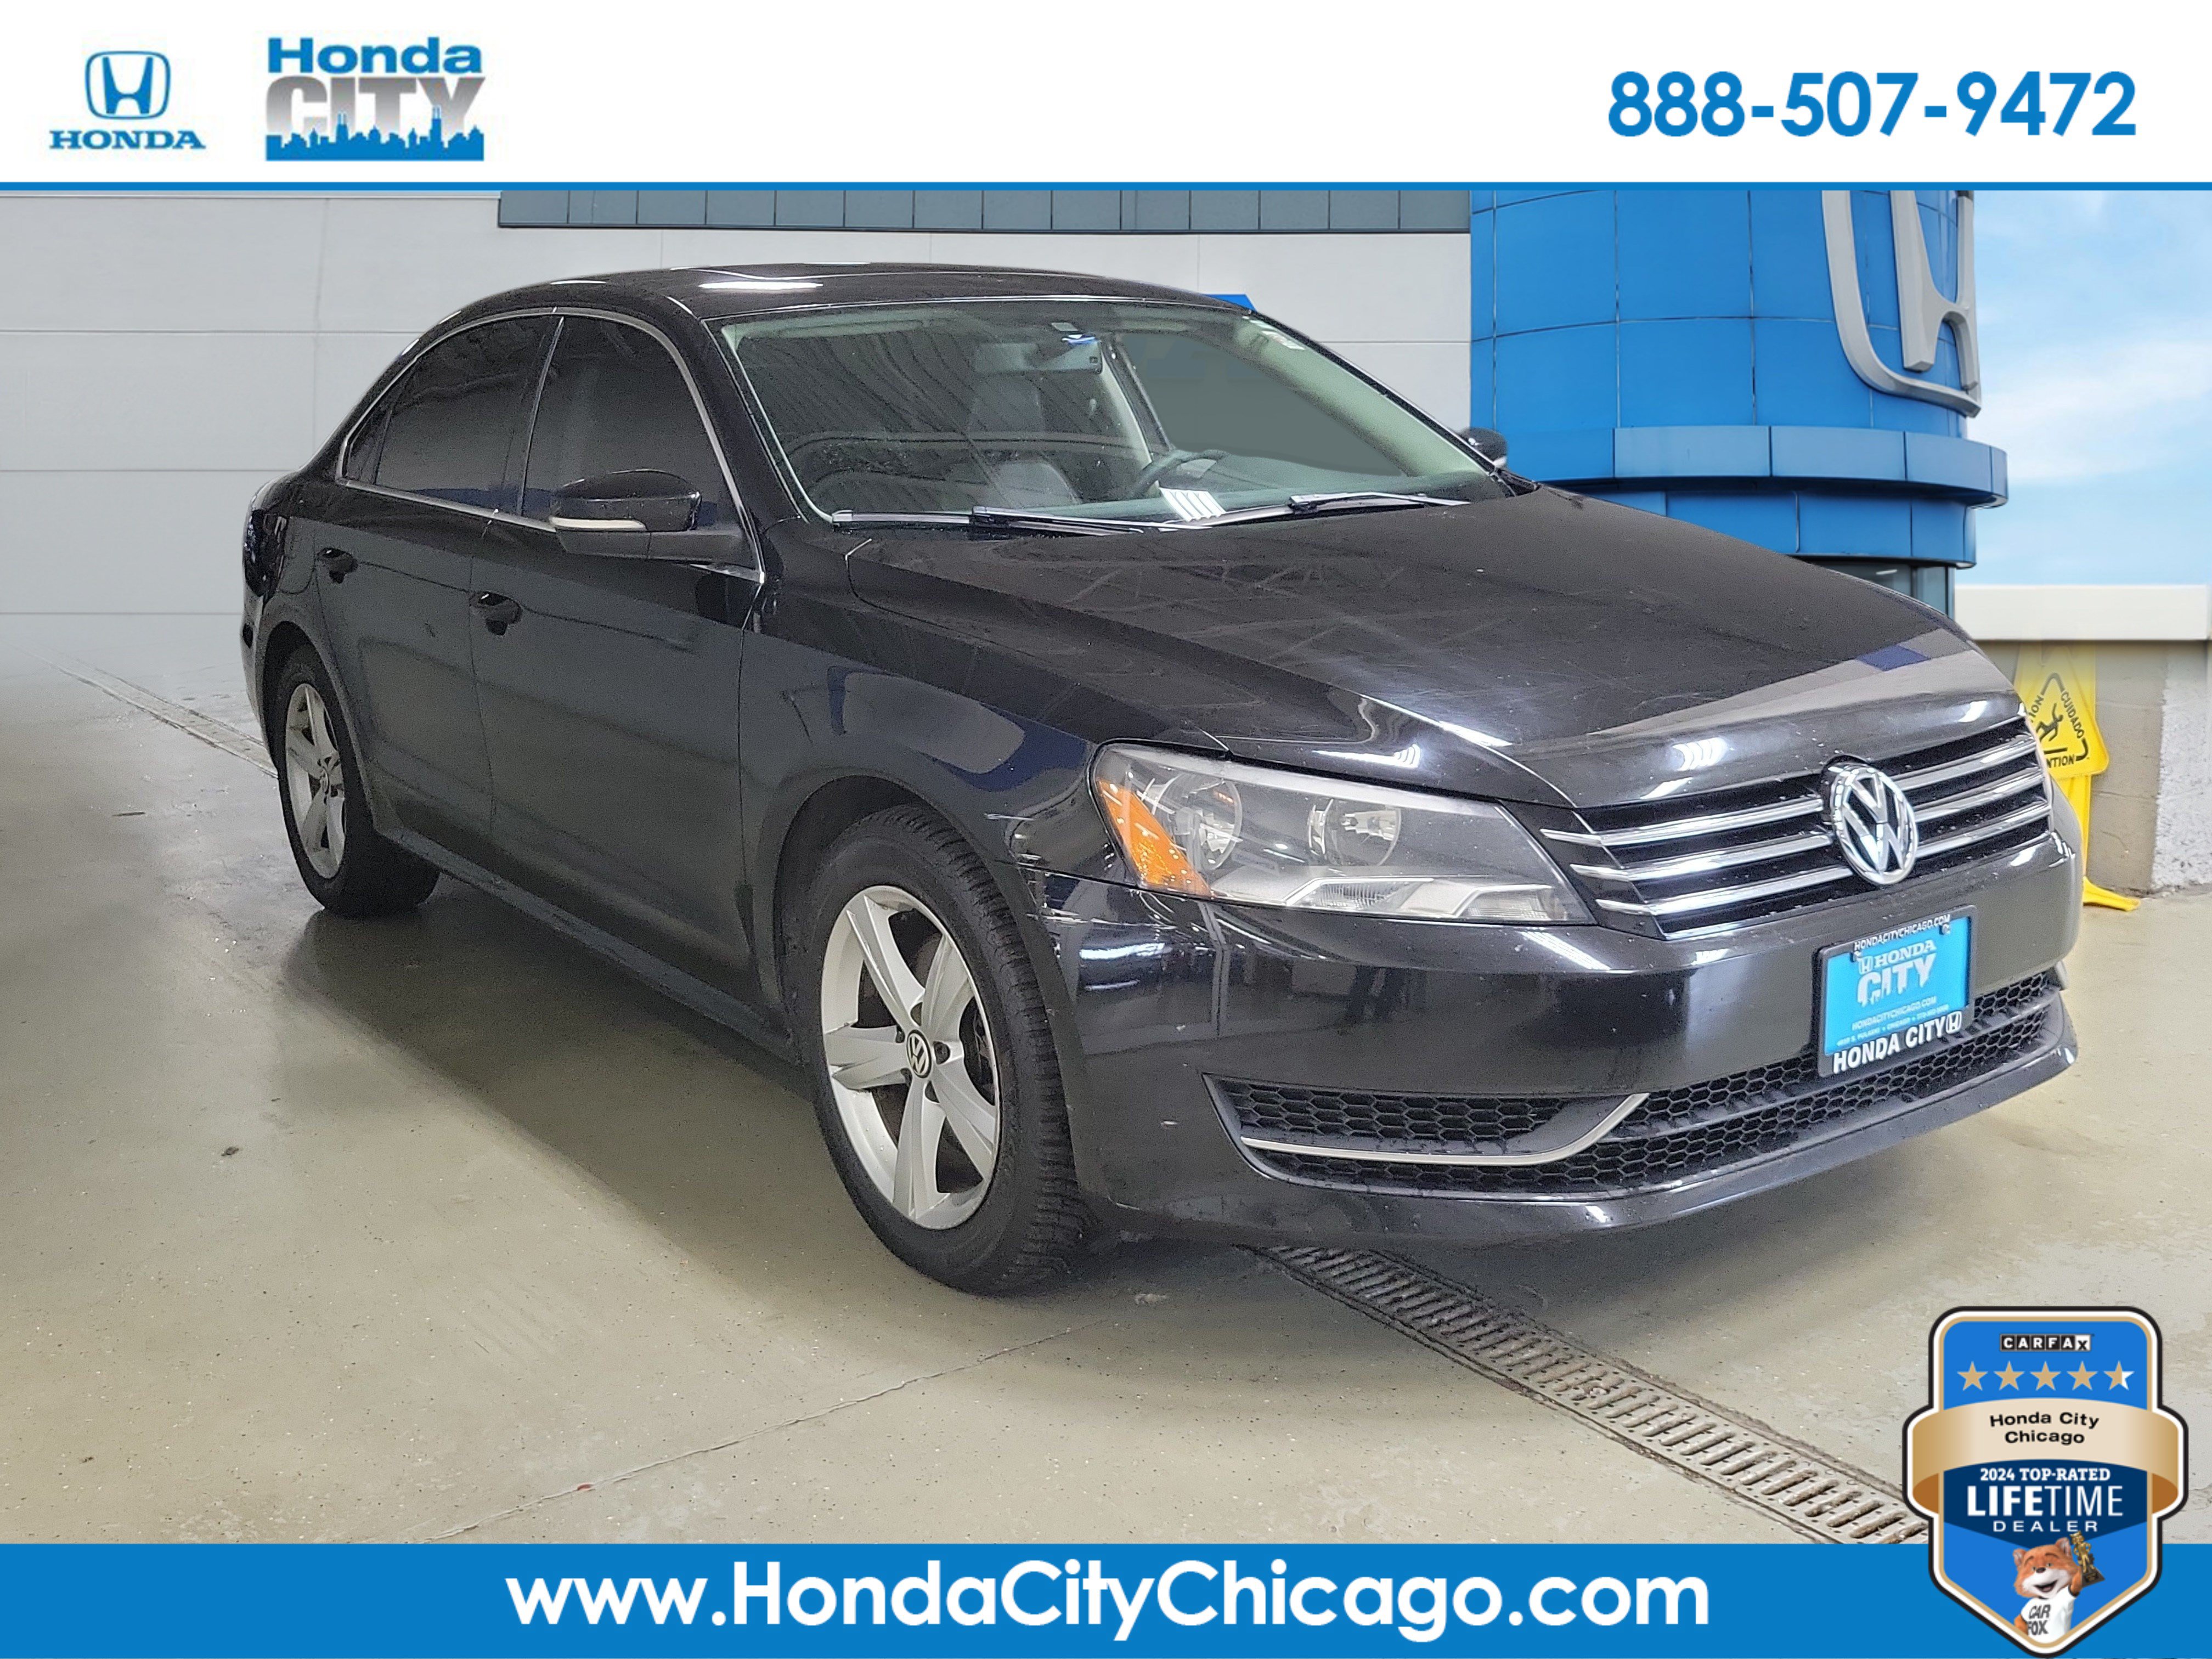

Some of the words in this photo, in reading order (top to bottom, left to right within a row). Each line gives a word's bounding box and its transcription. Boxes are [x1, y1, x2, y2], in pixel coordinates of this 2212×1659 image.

[2061, 691, 2085, 739] CUIDADO
[2046, 754, 2074, 769] NTION
[1854, 913, 1950, 951] HONDACITYCHICAGO.COM
[1874, 939, 1937, 969] HONDA
[1857, 952, 1937, 1007] CITY
[1833, 1034, 1900, 1074] HONDA
[1905, 1015, 1946, 1048] CITY
